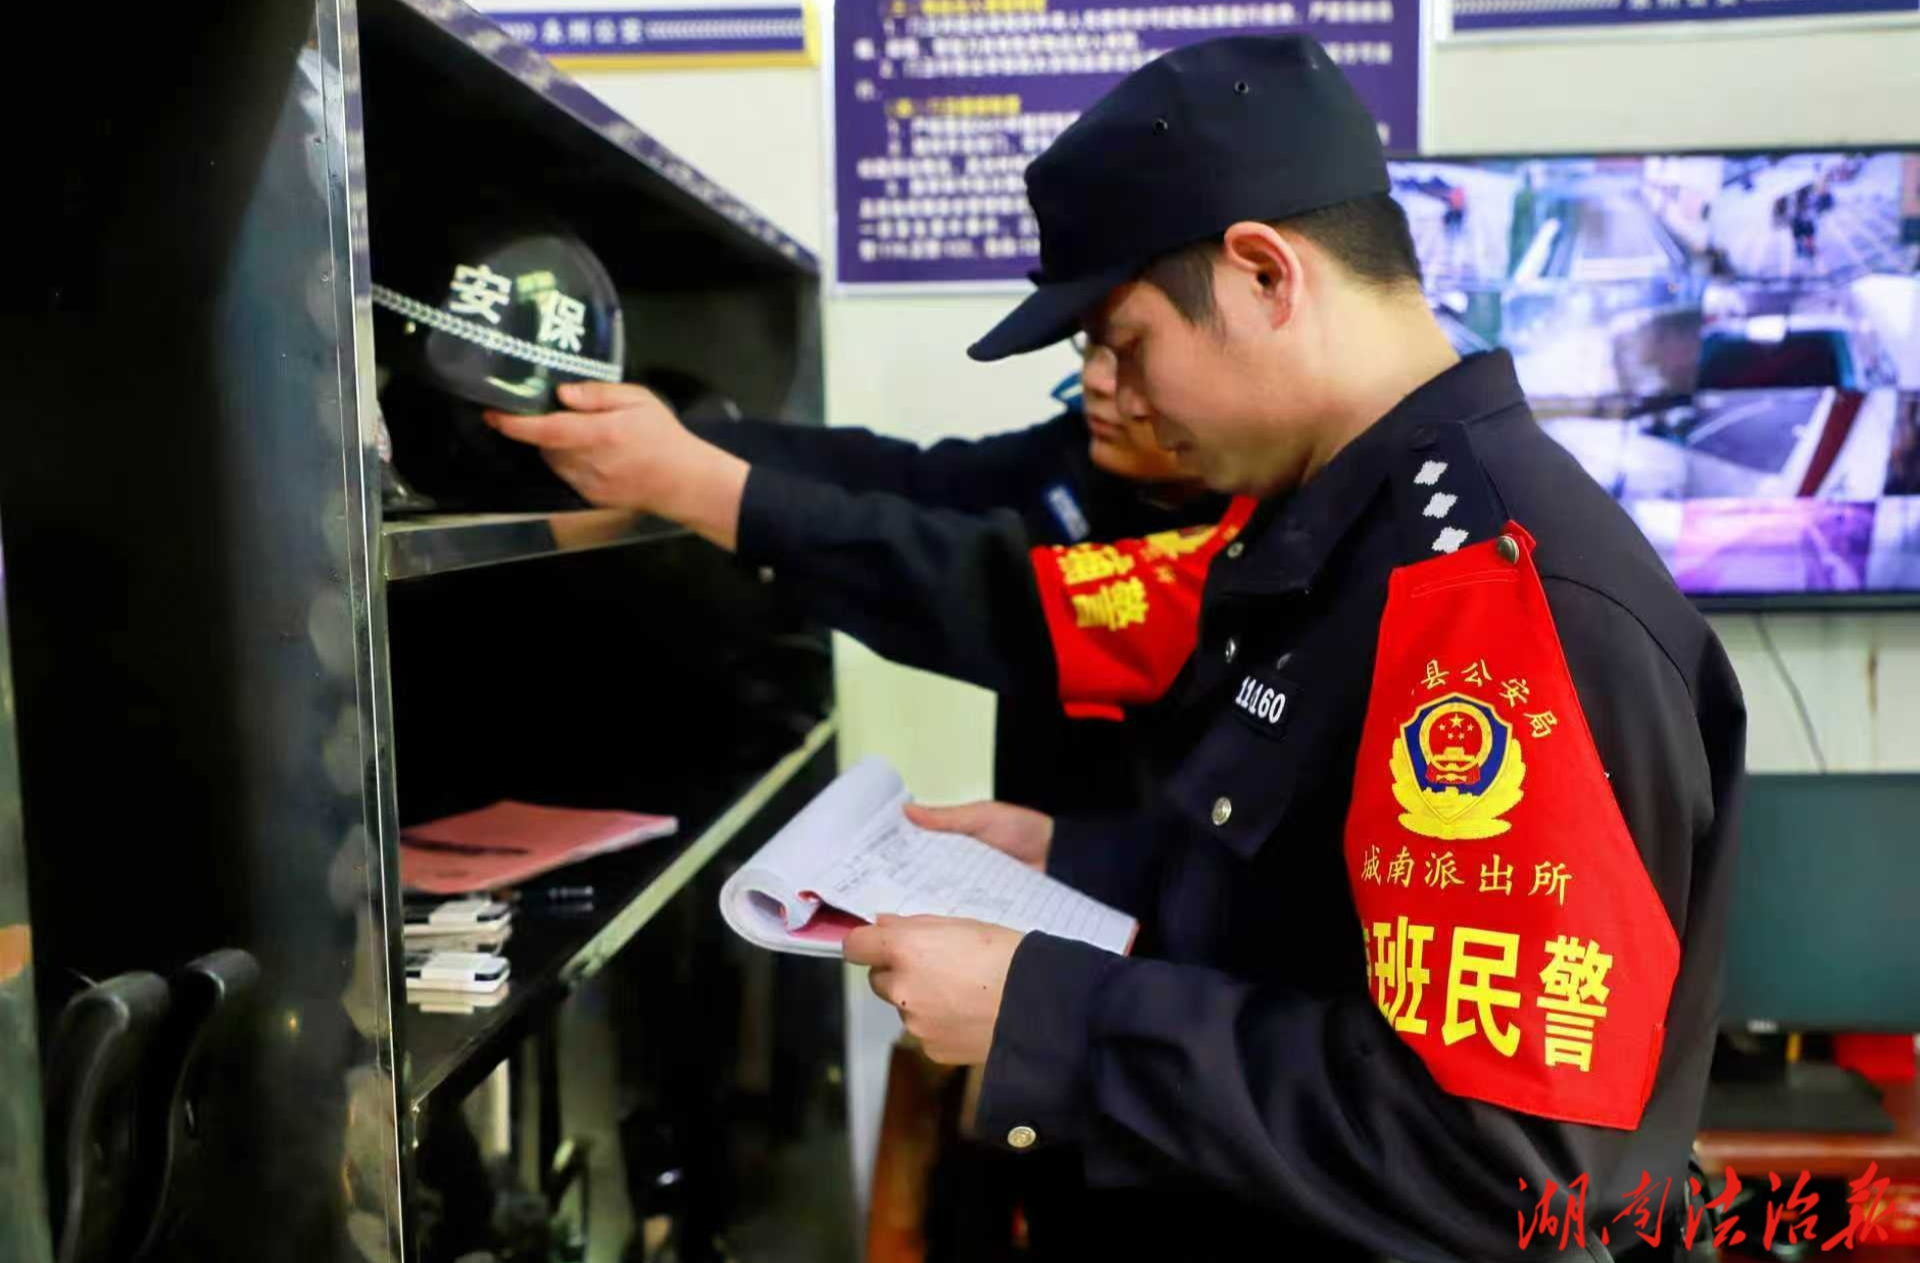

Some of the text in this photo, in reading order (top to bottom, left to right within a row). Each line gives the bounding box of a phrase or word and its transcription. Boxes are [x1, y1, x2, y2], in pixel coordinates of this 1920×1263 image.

[449, 264, 586, 352] 安保
[1361, 843, 1573, 905] 城南派出所
[1362, 916, 1614, 1072] 班民警
